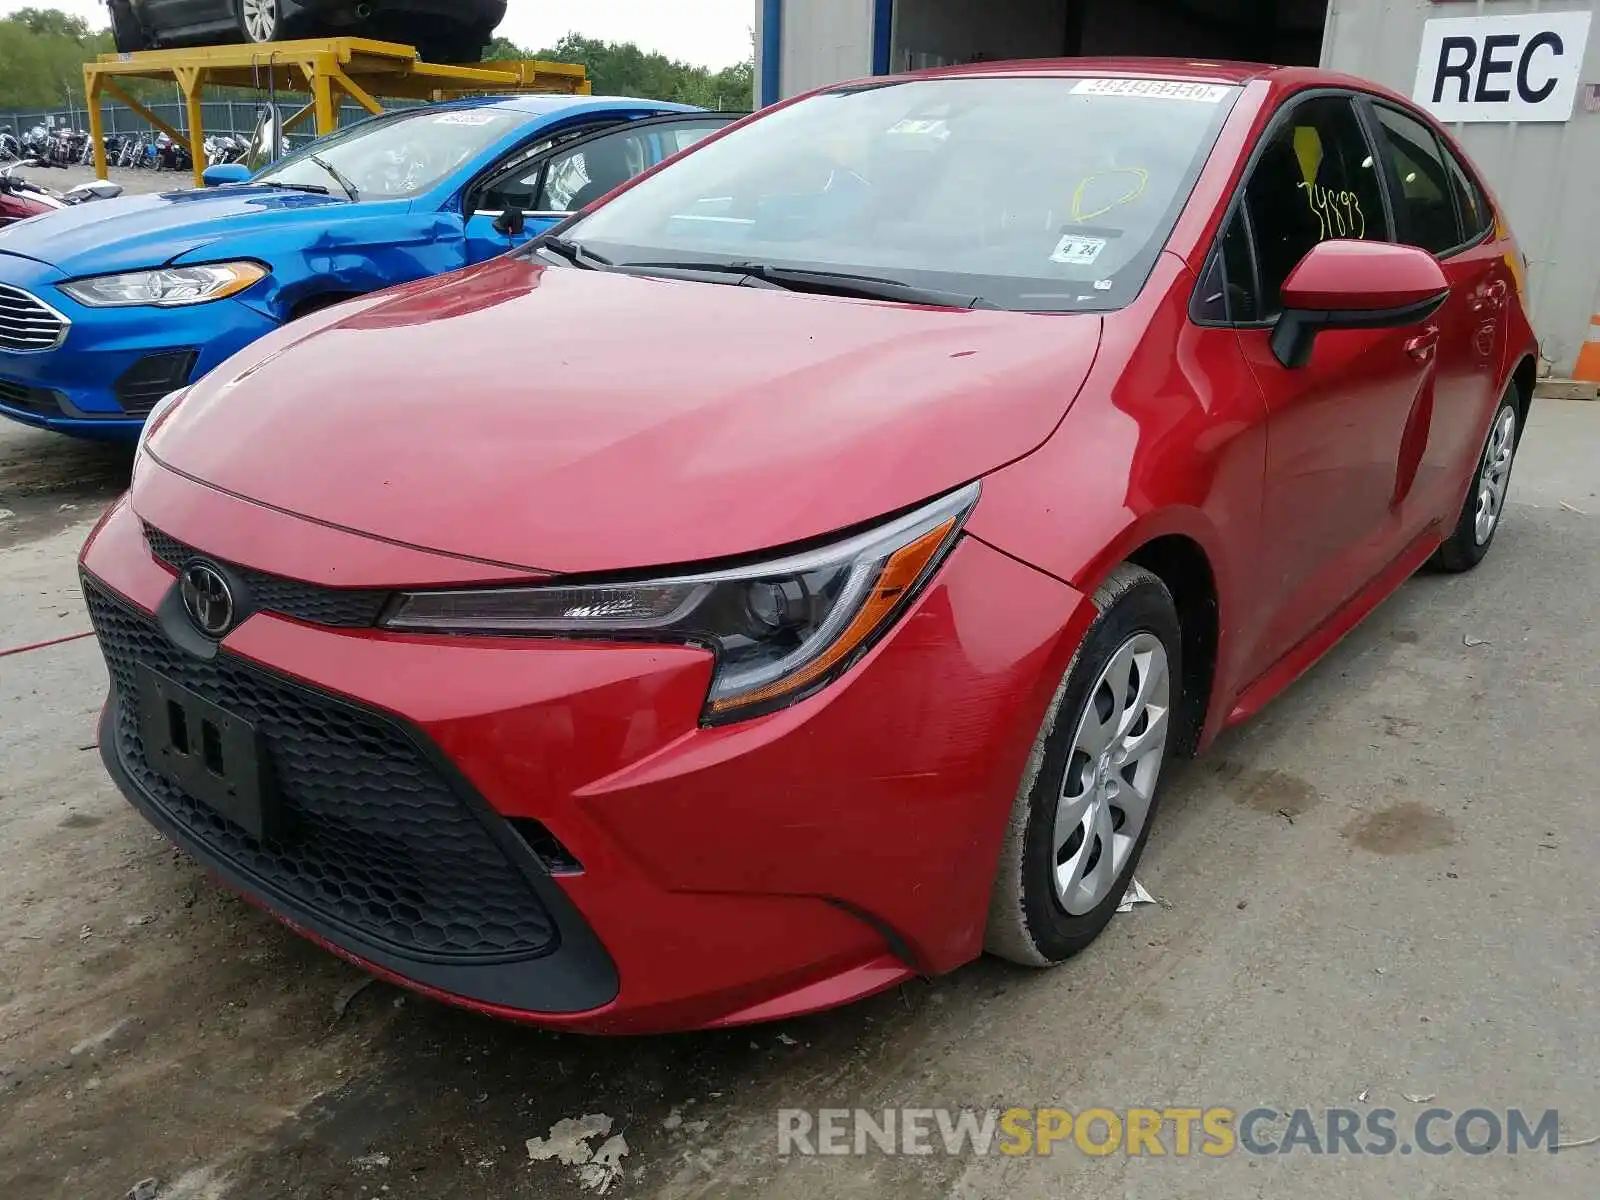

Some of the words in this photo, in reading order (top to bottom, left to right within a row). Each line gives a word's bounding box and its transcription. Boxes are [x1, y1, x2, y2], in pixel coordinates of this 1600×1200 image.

[1432, 31, 1564, 103] REC
[1296, 181, 1365, 240] 34893
[1063, 243, 1073, 254] 4
[1079, 244, 1098, 255] 24
